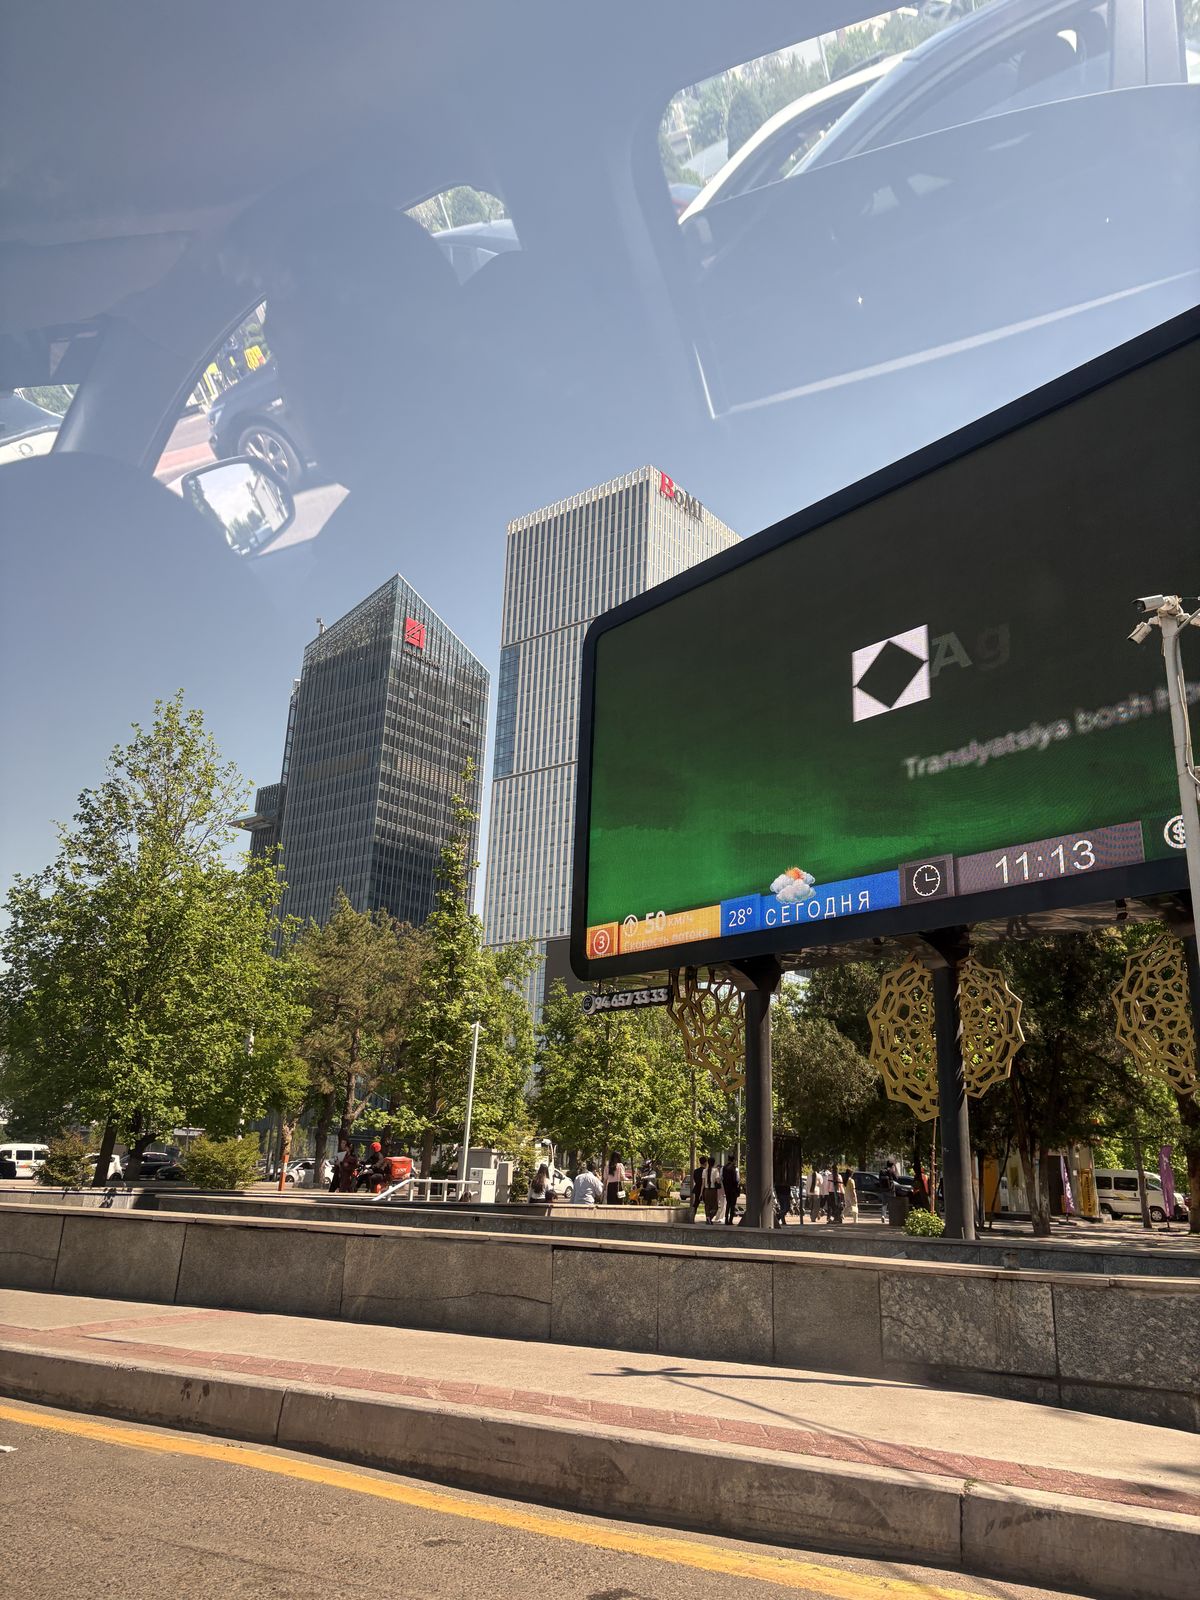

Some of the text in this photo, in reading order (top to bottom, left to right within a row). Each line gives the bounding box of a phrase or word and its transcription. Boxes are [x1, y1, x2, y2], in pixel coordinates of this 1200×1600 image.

[995, 839, 1096, 884] 11:13
[644, 910, 666, 934] 50
[728, 890, 870, 927] 28° СЕГОДНЯ
[611, 992, 634, 1008] 657
[633, 990, 650, 1005] 33
[650, 988, 669, 1002] 33
